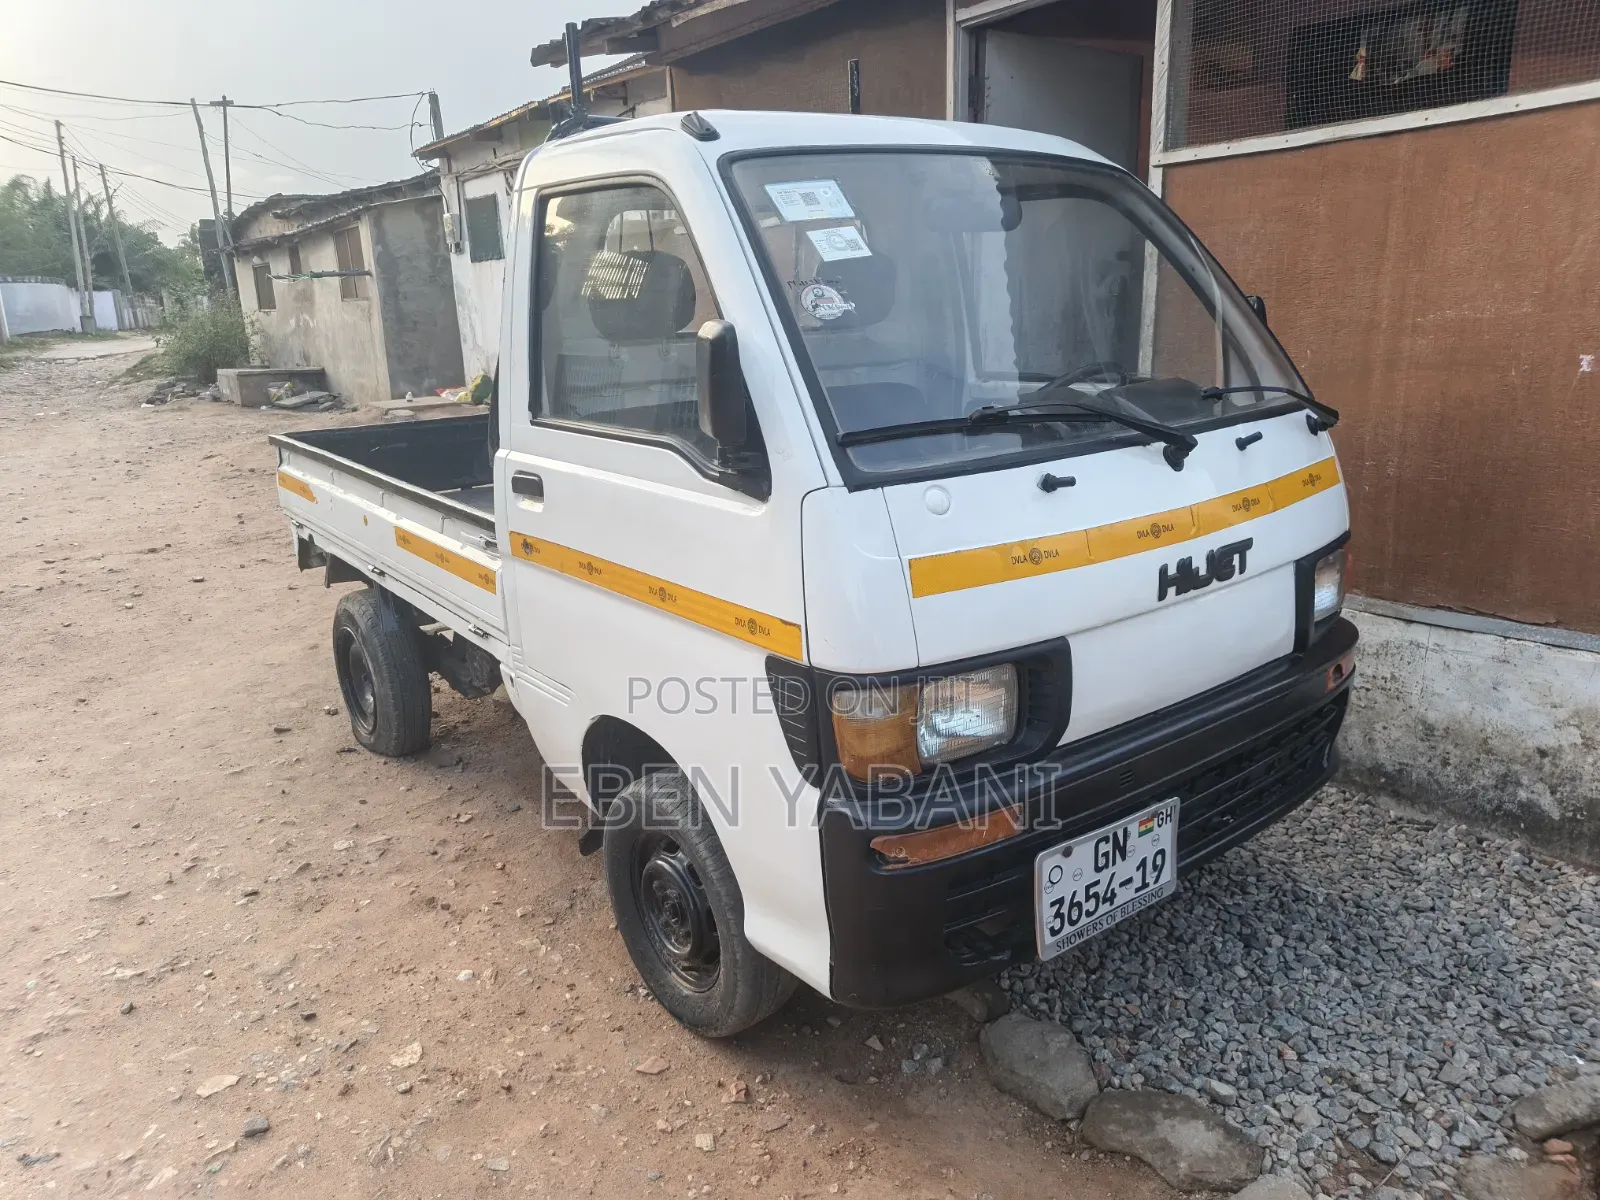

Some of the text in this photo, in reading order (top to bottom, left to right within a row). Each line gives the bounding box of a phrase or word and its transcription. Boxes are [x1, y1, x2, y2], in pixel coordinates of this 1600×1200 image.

[1137, 523, 1175, 539] DVLA DVLA
[1011, 549, 1060, 565] DVLA DVLA
[735, 617, 770, 636] DVLA DVLA
[1157, 805, 1173, 828] GH
[1094, 826, 1128, 873] GN
[1050, 848, 1166, 937] 3654-19
[1056, 888, 1164, 952] SHOWERS OF BLESSING
